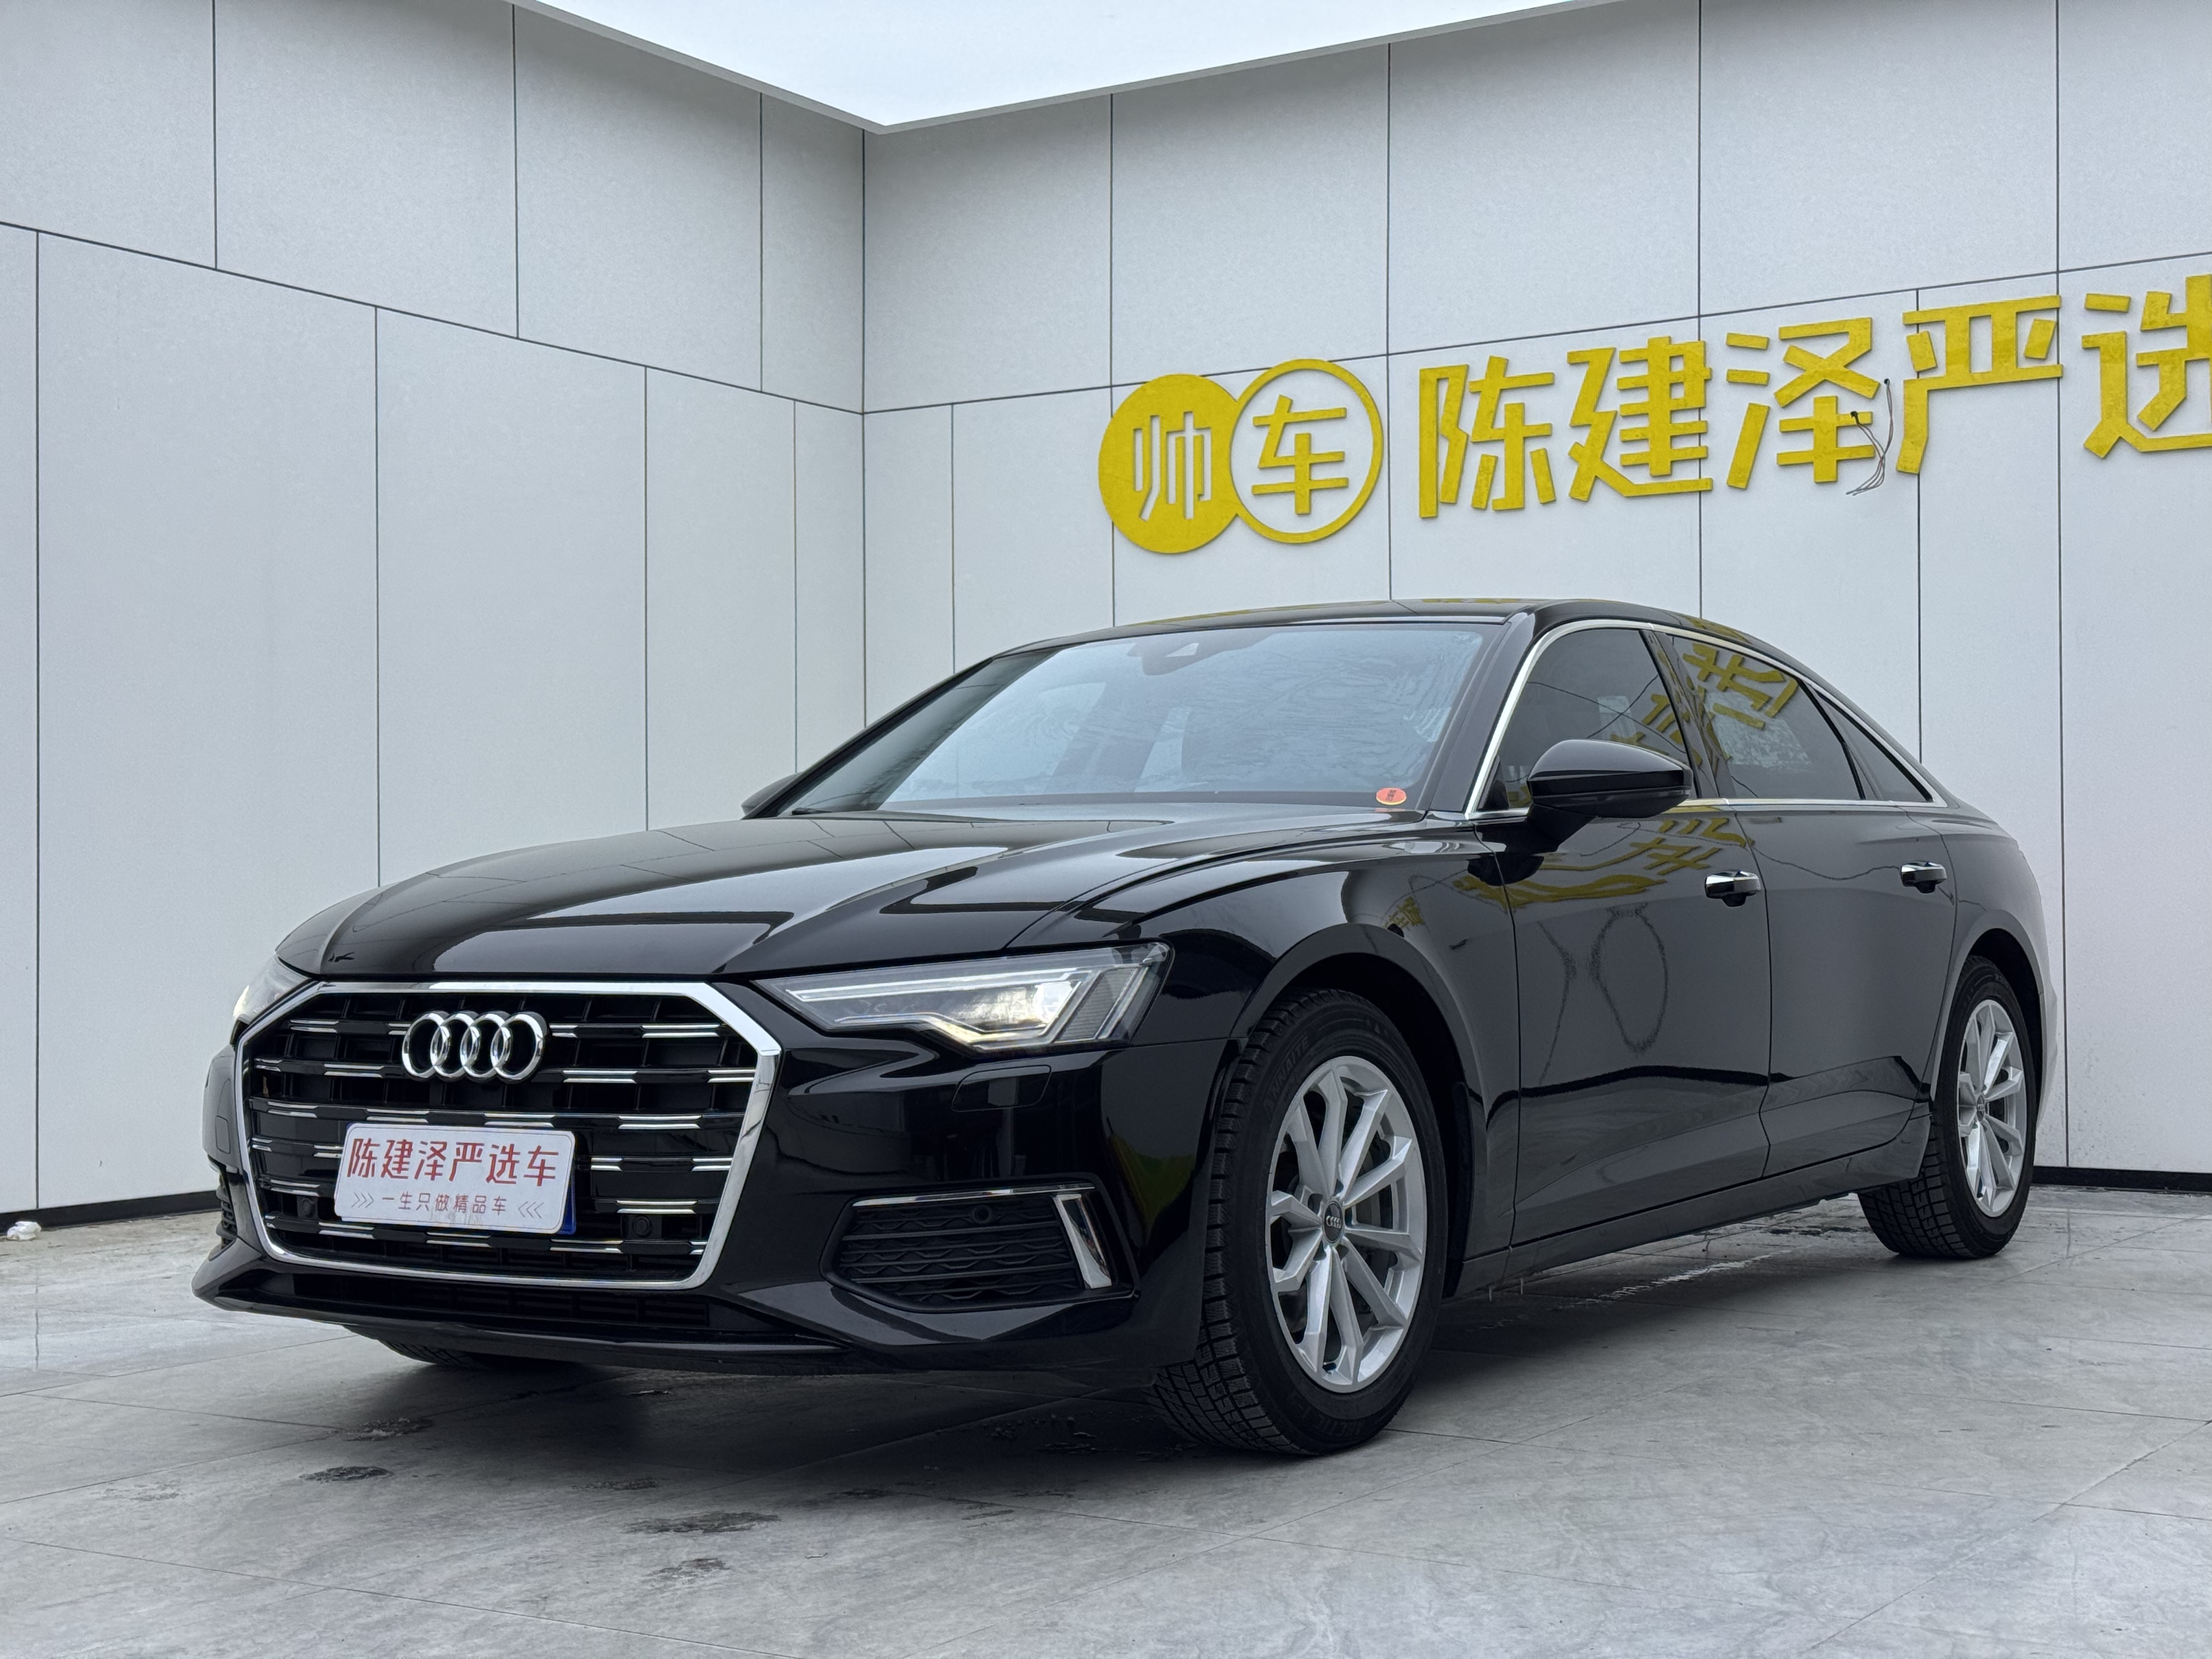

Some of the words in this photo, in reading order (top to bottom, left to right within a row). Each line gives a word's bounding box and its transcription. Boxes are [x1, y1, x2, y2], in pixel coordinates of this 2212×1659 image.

[346, 1137, 560, 1187] 陈建泽严选车
[382, 1190, 507, 1216] 一生只做精品车
